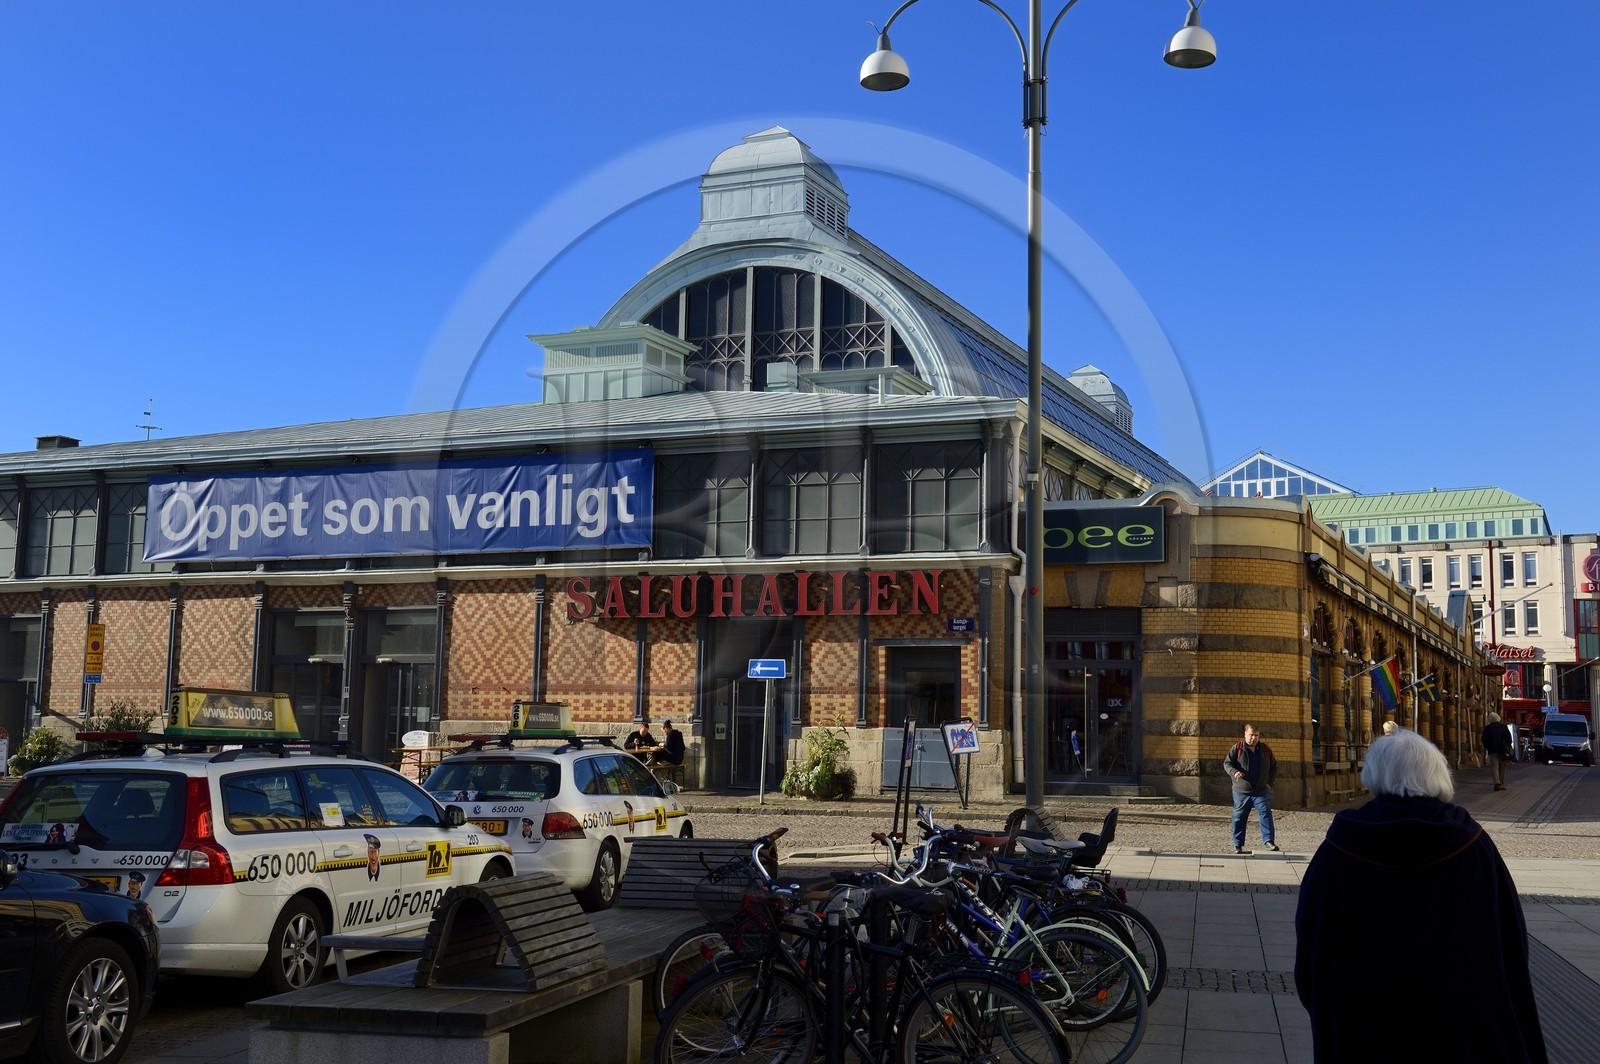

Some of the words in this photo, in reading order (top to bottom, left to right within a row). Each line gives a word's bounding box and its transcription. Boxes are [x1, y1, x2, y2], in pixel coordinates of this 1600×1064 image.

[160, 480, 309, 552] Öppet
[322, 495, 430, 536] som
[446, 473, 636, 539] vanligt
[566, 569, 944, 620] SALUHALLEN
[1483, 641, 1535, 659] latset
[170, 695, 180, 726] 203
[491, 805, 507, 814] 650
[508, 805, 524, 814] 000
[583, 812, 598, 830] 650
[599, 811, 613, 828] 000
[467, 834, 480, 845] 203
[120, 854, 143, 866] 650
[144, 854, 169, 866] 000
[248, 854, 281, 881] 650
[285, 850, 317, 877] 000
[343, 887, 452, 928] MILJÖFORD
